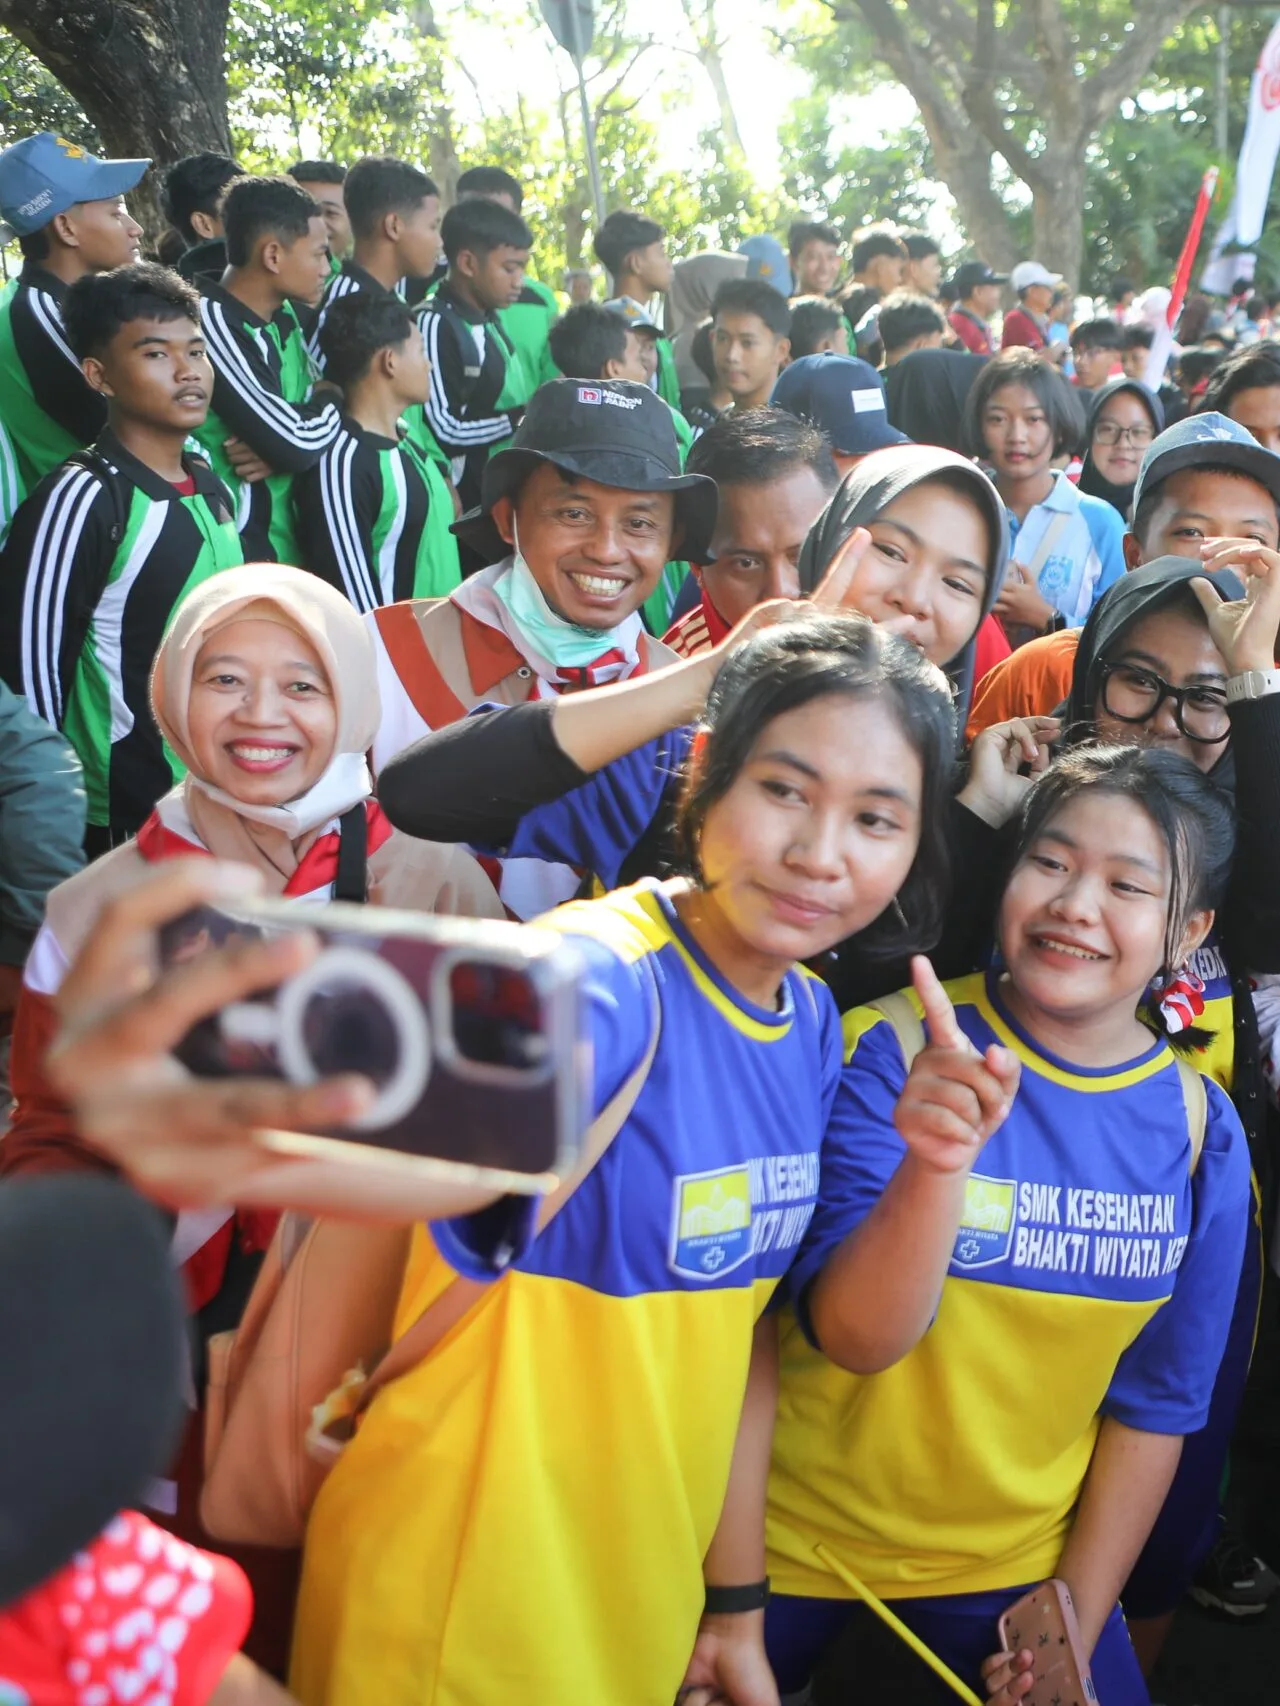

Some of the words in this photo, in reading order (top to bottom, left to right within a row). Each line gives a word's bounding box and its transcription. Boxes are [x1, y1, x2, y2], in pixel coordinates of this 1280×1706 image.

[602, 390, 643, 405] NIPPON
[605, 397, 637, 410] PAINT
[1018, 1181, 1061, 1225] SMK
[1065, 1187, 1175, 1233] KESEHATAN
[1012, 1227, 1090, 1275] BHAKTI
[1093, 1236, 1161, 1279] WIYATA
